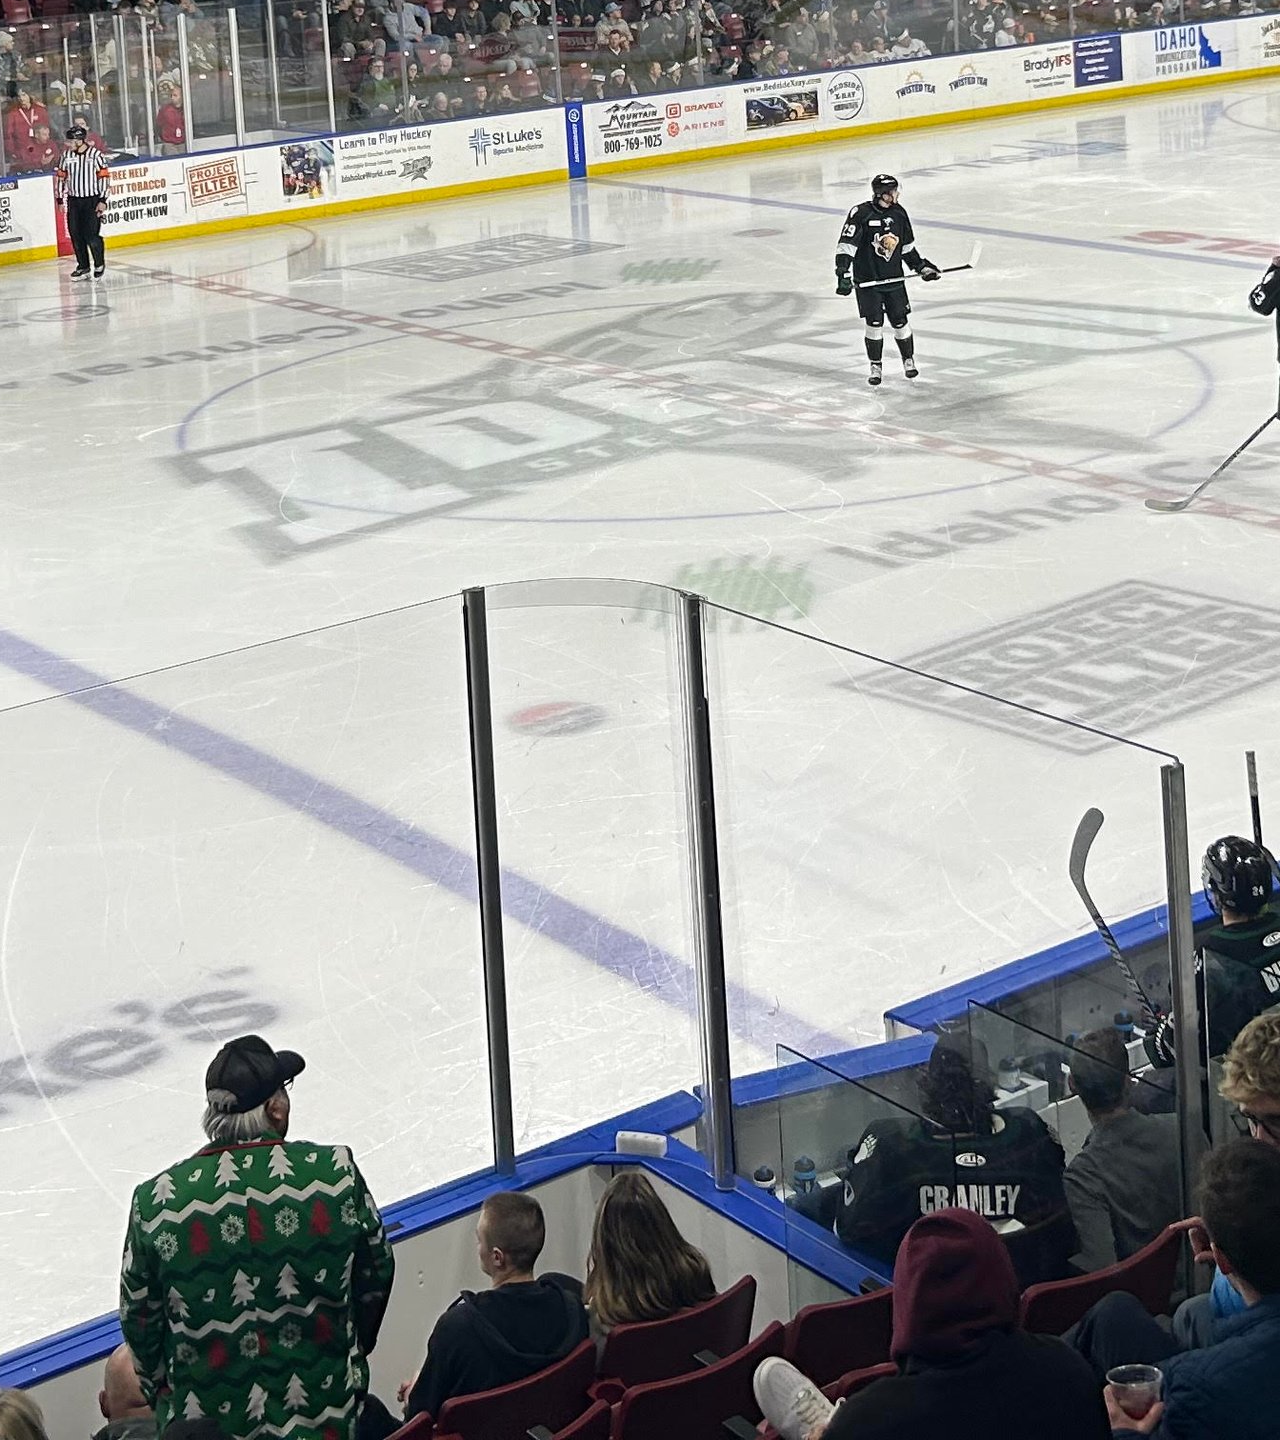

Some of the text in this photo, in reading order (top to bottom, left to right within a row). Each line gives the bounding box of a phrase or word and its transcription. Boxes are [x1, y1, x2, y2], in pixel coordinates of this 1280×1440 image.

[1154, 27, 1196, 52] IDAHO
[895, 83, 936, 99] TWISTED TEA
[948, 76, 988, 91] TWISTED TEA
[684, 101, 725, 113] GRAVELY
[610, 109, 658, 124] MOUNTAIN
[683, 119, 725, 132] ARIENS
[339, 127, 432, 150] Learn to Play Hockey
[492, 127, 543, 145] St Luke's
[604, 133, 663, 154] 800-769-1025
[128, 167, 150, 180] HELP
[189, 162, 236, 183] PROJECT
[126, 178, 167, 193] TOBACCO
[191, 175, 239, 197] FILTER
[107, 193, 169, 211] jectFilter.org
[102, 205, 169, 225] 800-QUIT-NOW
[832, 491, 1120, 570] Idaho
